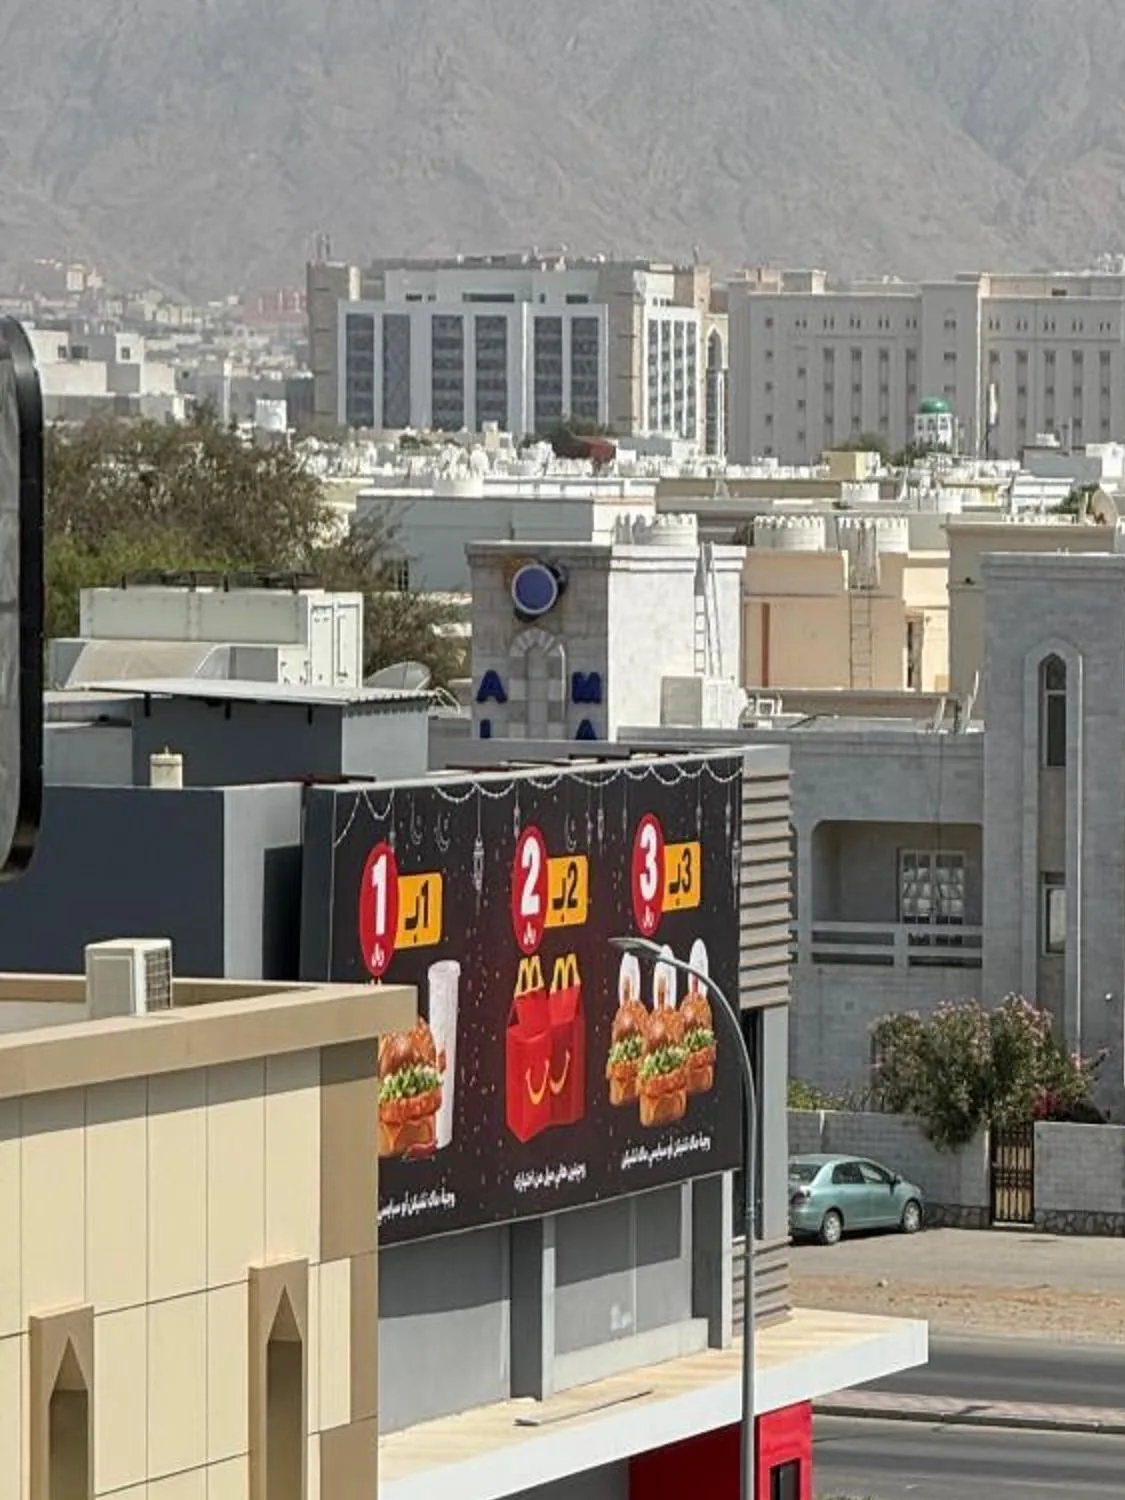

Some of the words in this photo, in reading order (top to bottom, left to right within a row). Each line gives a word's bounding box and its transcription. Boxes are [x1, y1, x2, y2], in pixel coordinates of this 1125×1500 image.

[371, 853, 387, 937] 1
[521, 836, 541, 916] 2
[639, 823, 658, 902] 3
